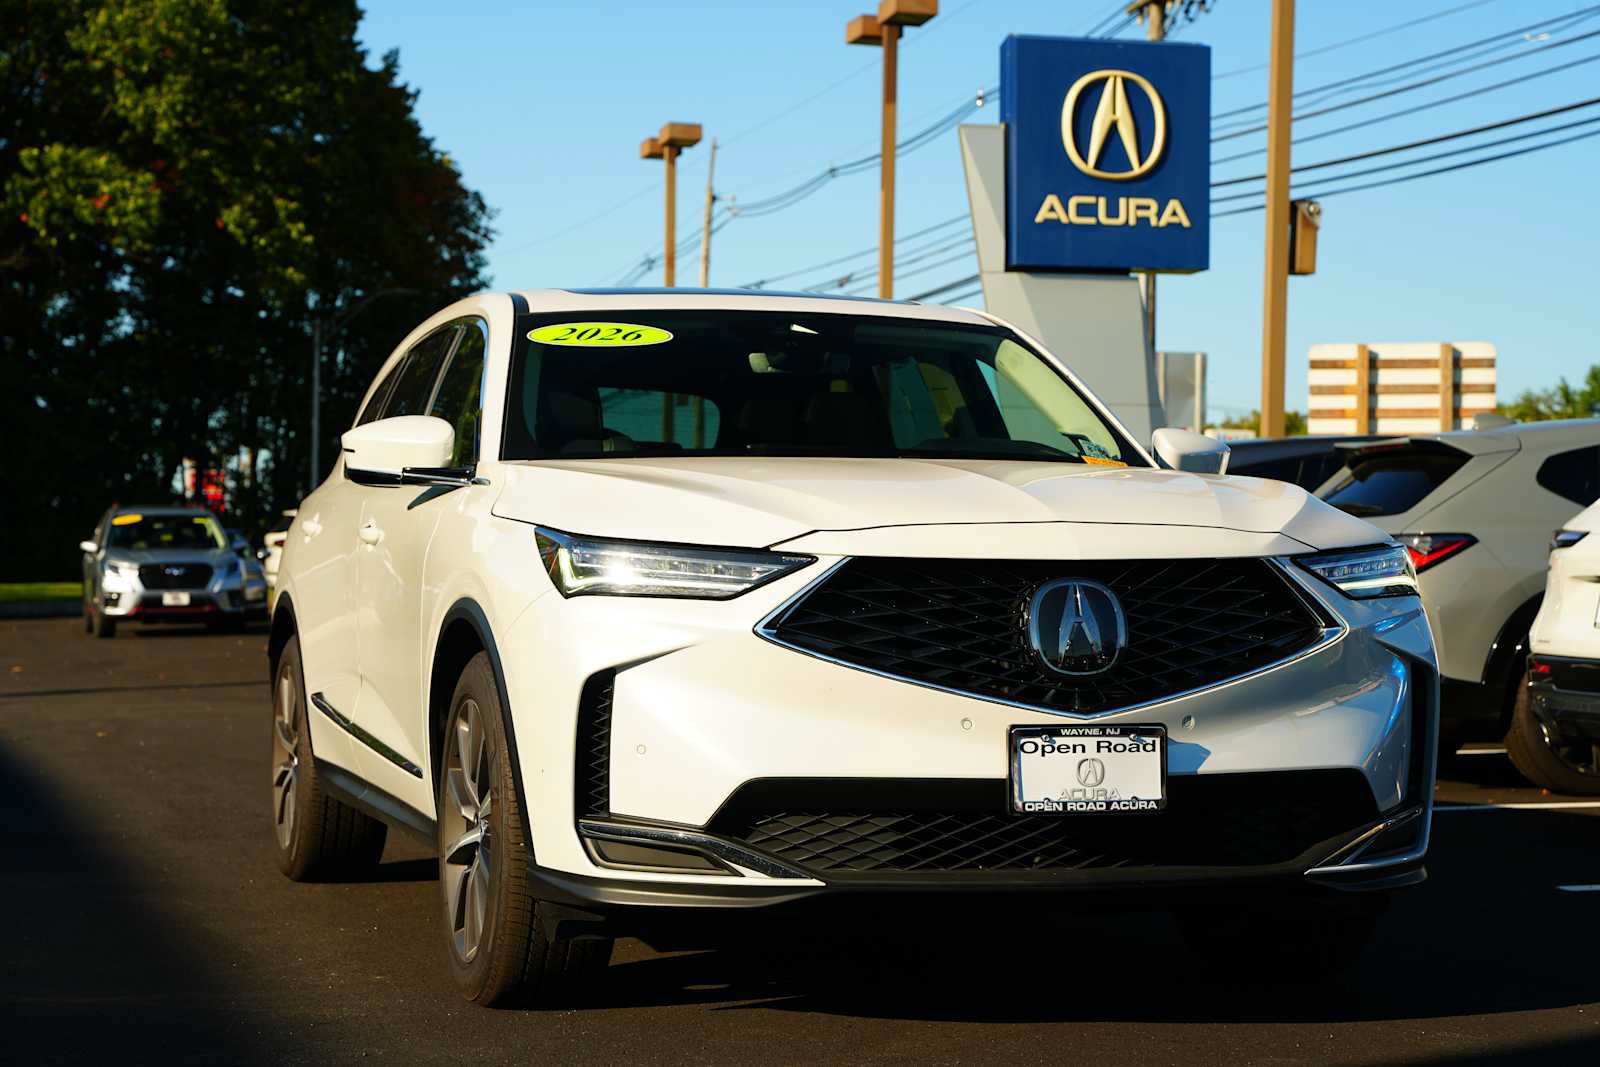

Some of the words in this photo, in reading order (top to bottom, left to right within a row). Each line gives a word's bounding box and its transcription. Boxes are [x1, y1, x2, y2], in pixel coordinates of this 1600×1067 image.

[1034, 194, 1192, 228] ACURA
[552, 327, 645, 341] 2026
[1021, 741, 1086, 757] Open
[1096, 740, 1156, 753] Road
[1058, 788, 1122, 801] ACURA
[1025, 802, 1063, 812] OPEN
[1067, 801, 1107, 811] ROAD
[1110, 800, 1158, 811] ACURA
